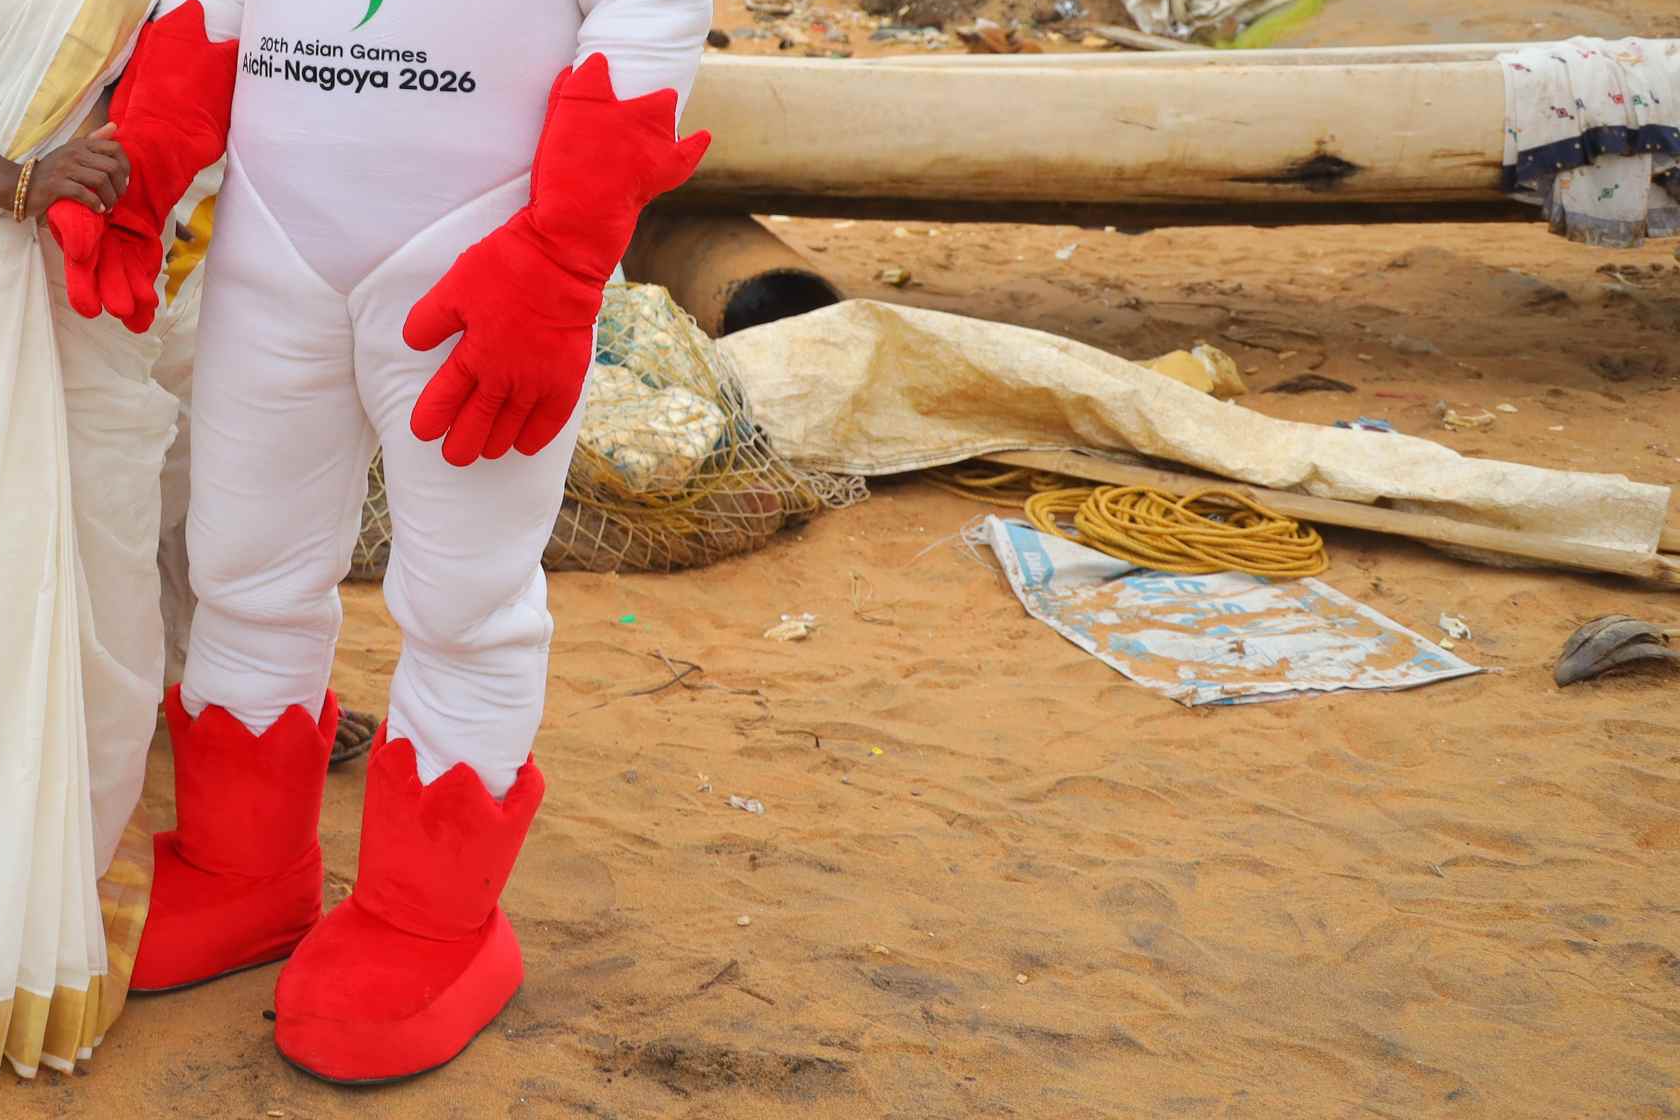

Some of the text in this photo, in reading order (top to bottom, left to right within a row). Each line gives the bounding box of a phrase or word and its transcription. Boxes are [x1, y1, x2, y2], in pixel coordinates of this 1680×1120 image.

[260, 36, 427, 63] 20th Asian Games
[242, 52, 476, 94] Aichi-Nagoya 2026
